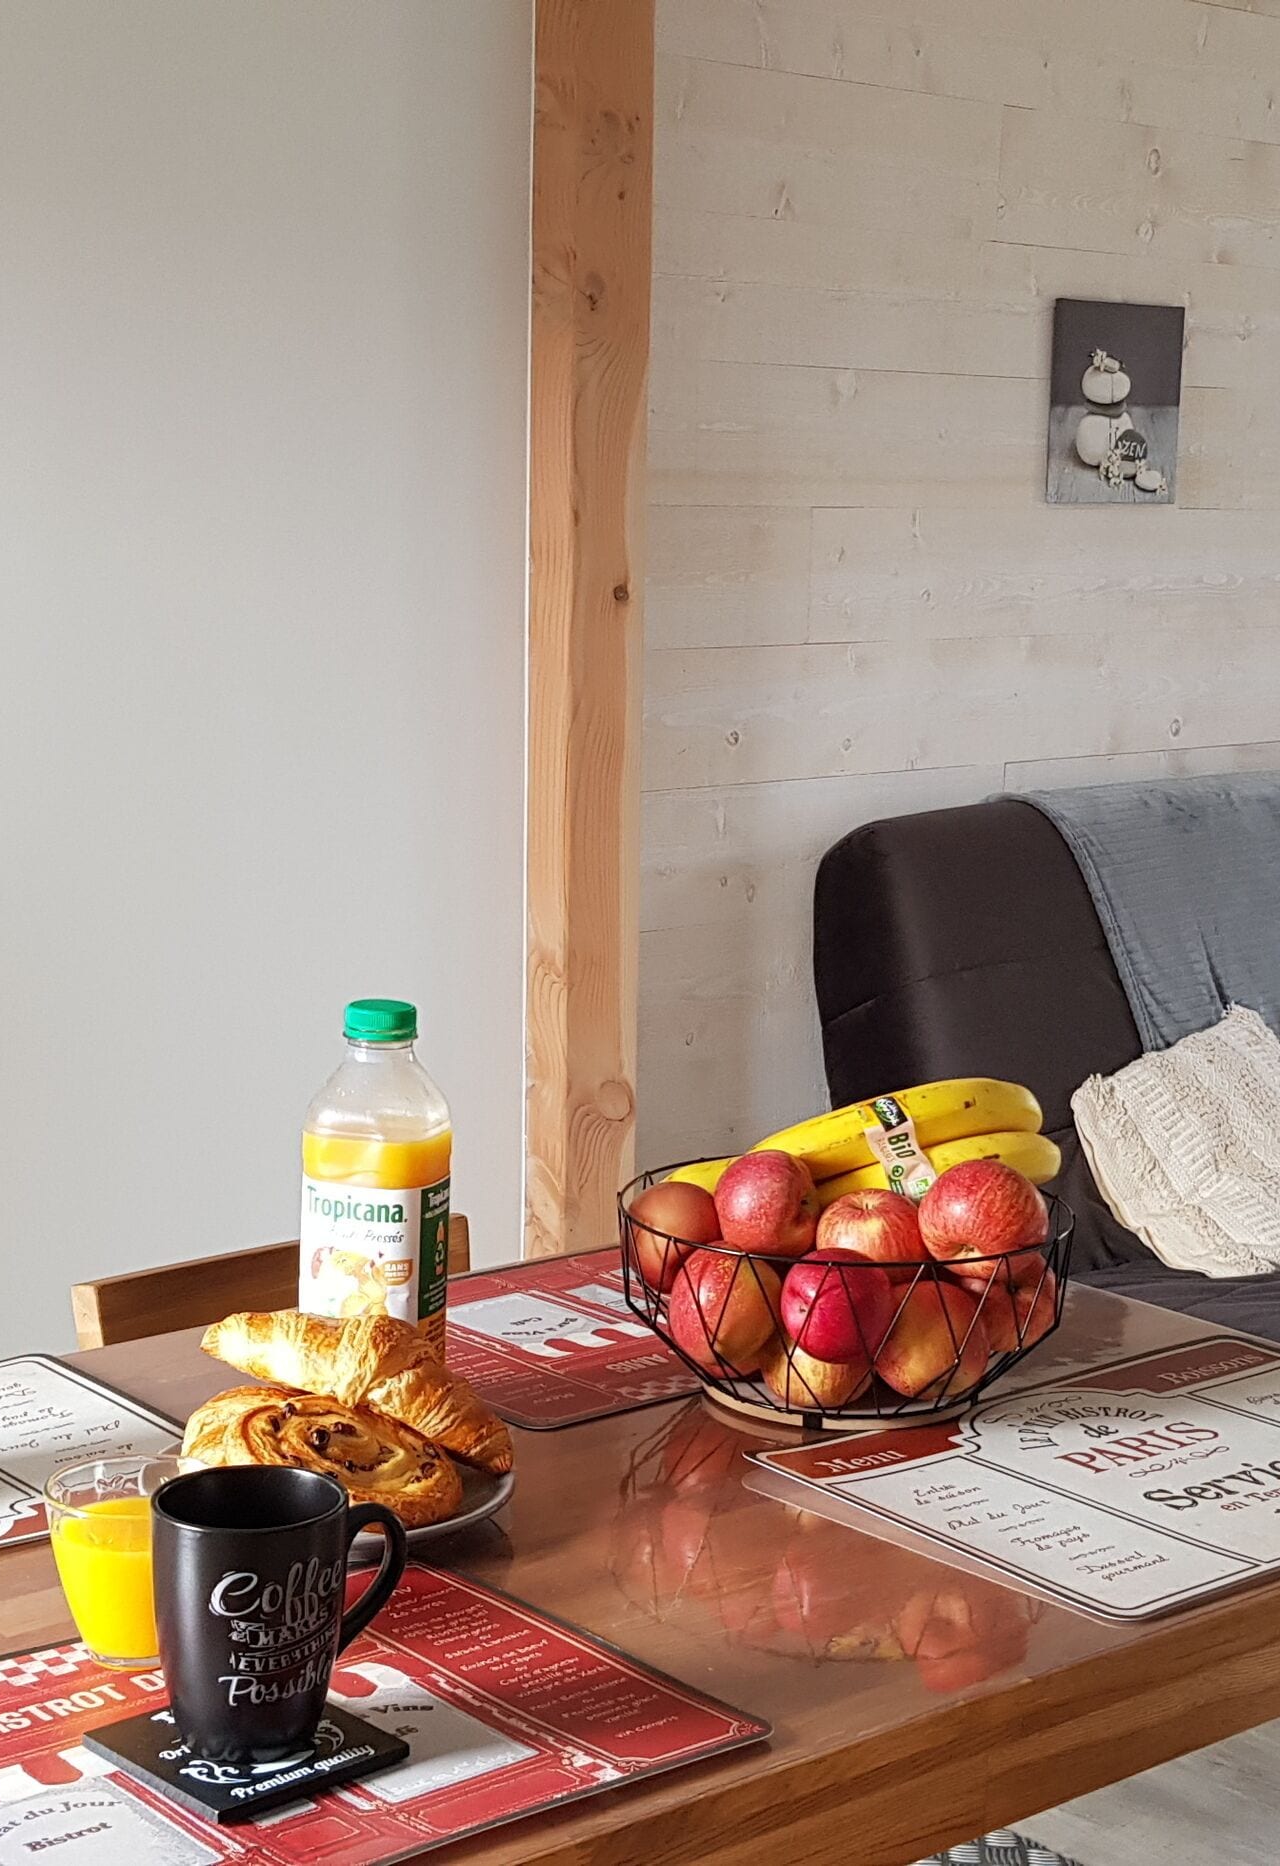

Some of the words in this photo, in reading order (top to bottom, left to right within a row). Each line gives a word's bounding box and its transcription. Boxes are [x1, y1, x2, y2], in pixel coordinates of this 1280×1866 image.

[1120, 440, 1147, 458] ZEN
[1157, 1351, 1265, 1384] Boissons
[1054, 1406, 1164, 1422] BISTROT
[1080, 1423, 1119, 1439] de
[1054, 1422, 1220, 1474] PARIS
[814, 1450, 908, 1473] Menu
[1012, 1499, 1051, 1514] Jour
[1220, 1500, 1250, 1512] en
[209, 1557, 342, 1625] Coffee
[230, 1765, 314, 1799] Premium
[314, 1743, 375, 1774] quality
[24, 1807, 56, 1821] du
[22, 1821, 113, 1852] Bistrot
